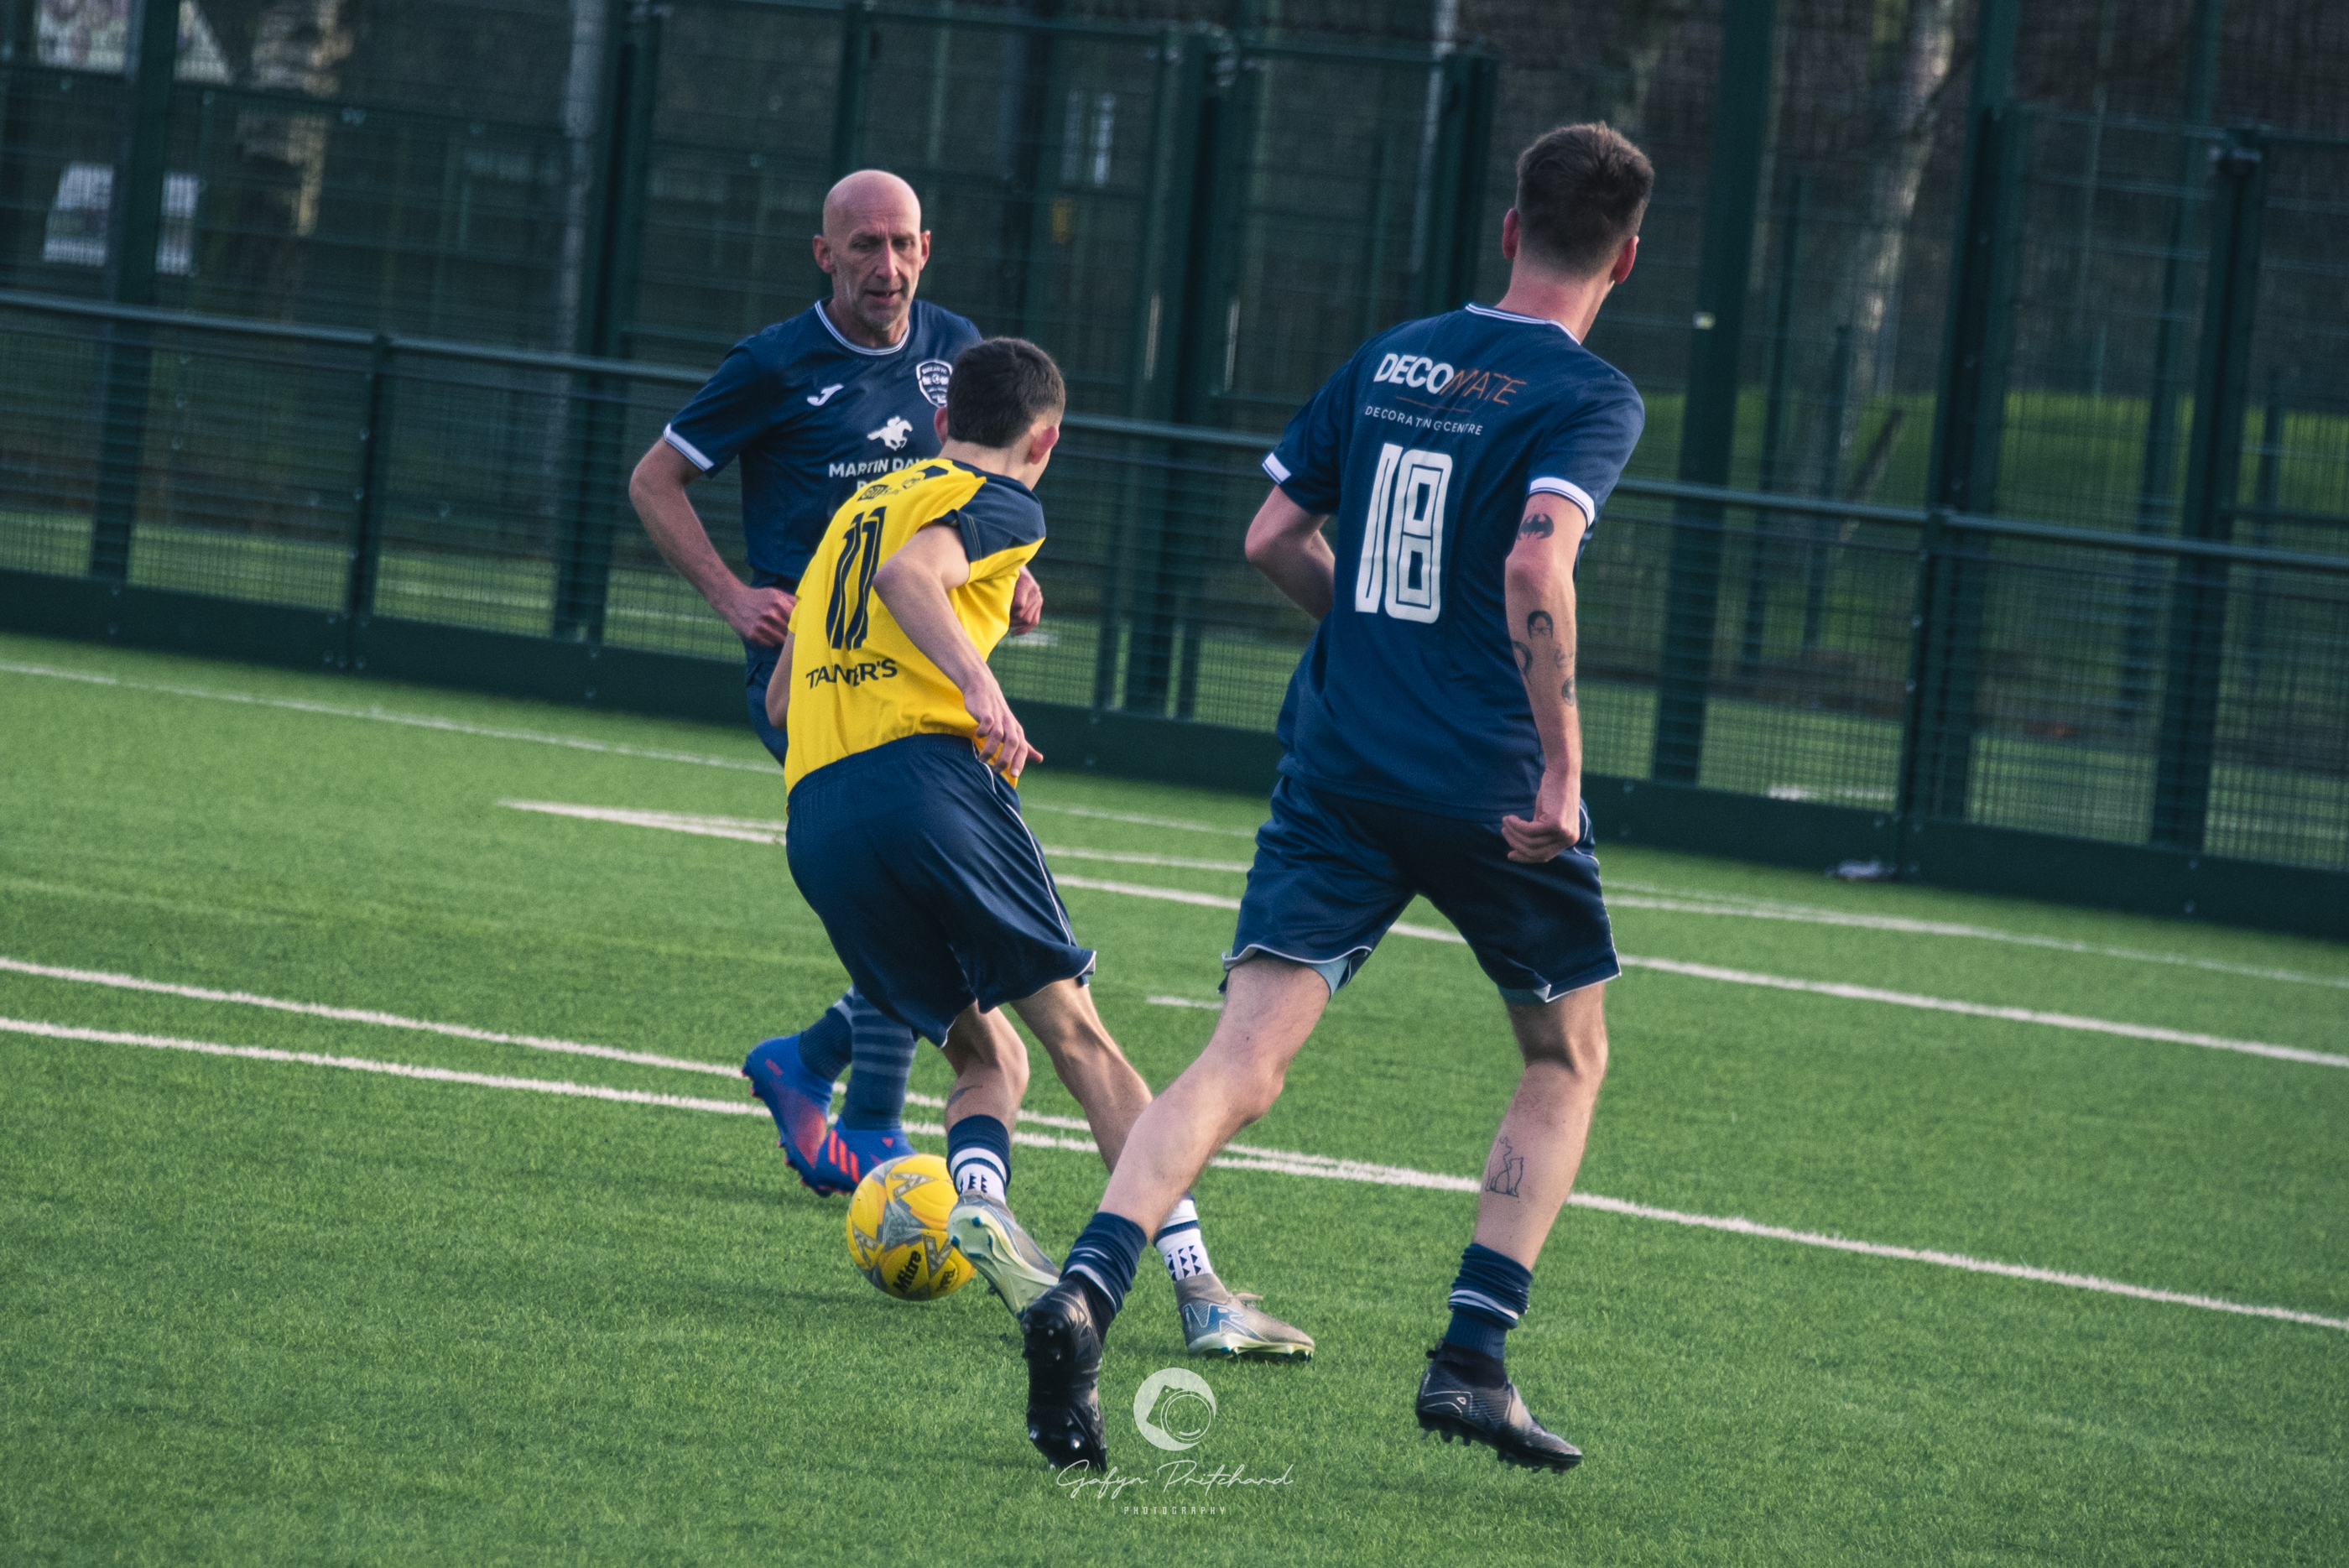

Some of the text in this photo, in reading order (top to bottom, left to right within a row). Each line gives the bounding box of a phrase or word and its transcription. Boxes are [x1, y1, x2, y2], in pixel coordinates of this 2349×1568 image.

[1373, 353, 1527, 405] DECOMATE
[1443, 421, 1483, 435] CENTRE
[828, 458, 889, 478] MARTIN
[1355, 442, 1453, 624] 18
[825, 505, 887, 651] 11
